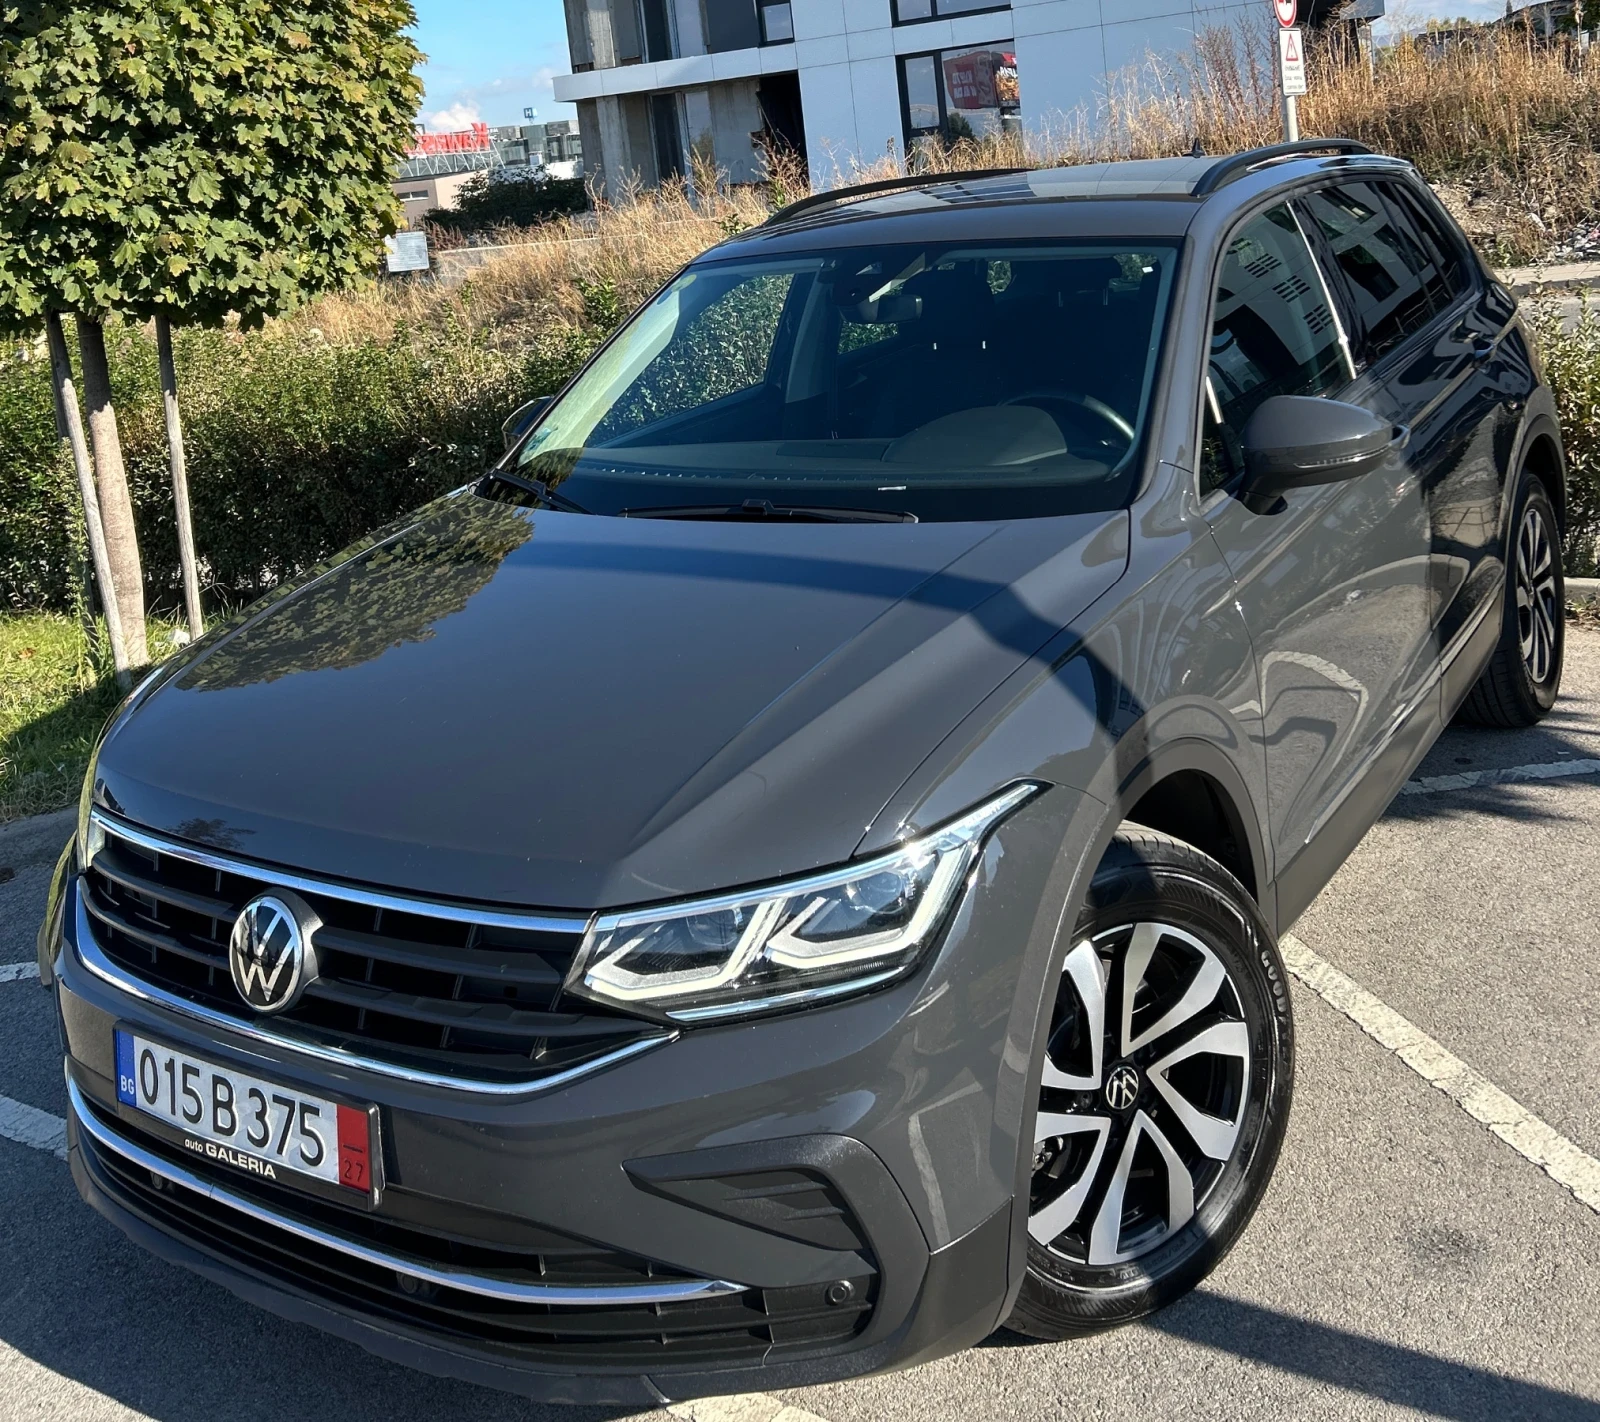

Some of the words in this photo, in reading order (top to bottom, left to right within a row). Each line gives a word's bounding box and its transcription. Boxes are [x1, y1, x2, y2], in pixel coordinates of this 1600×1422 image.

[120, 1074, 135, 1095] BG
[184, 1138, 203, 1152] auto
[205, 1142, 277, 1180] GALERIA
[343, 1159, 364, 1182] 27
